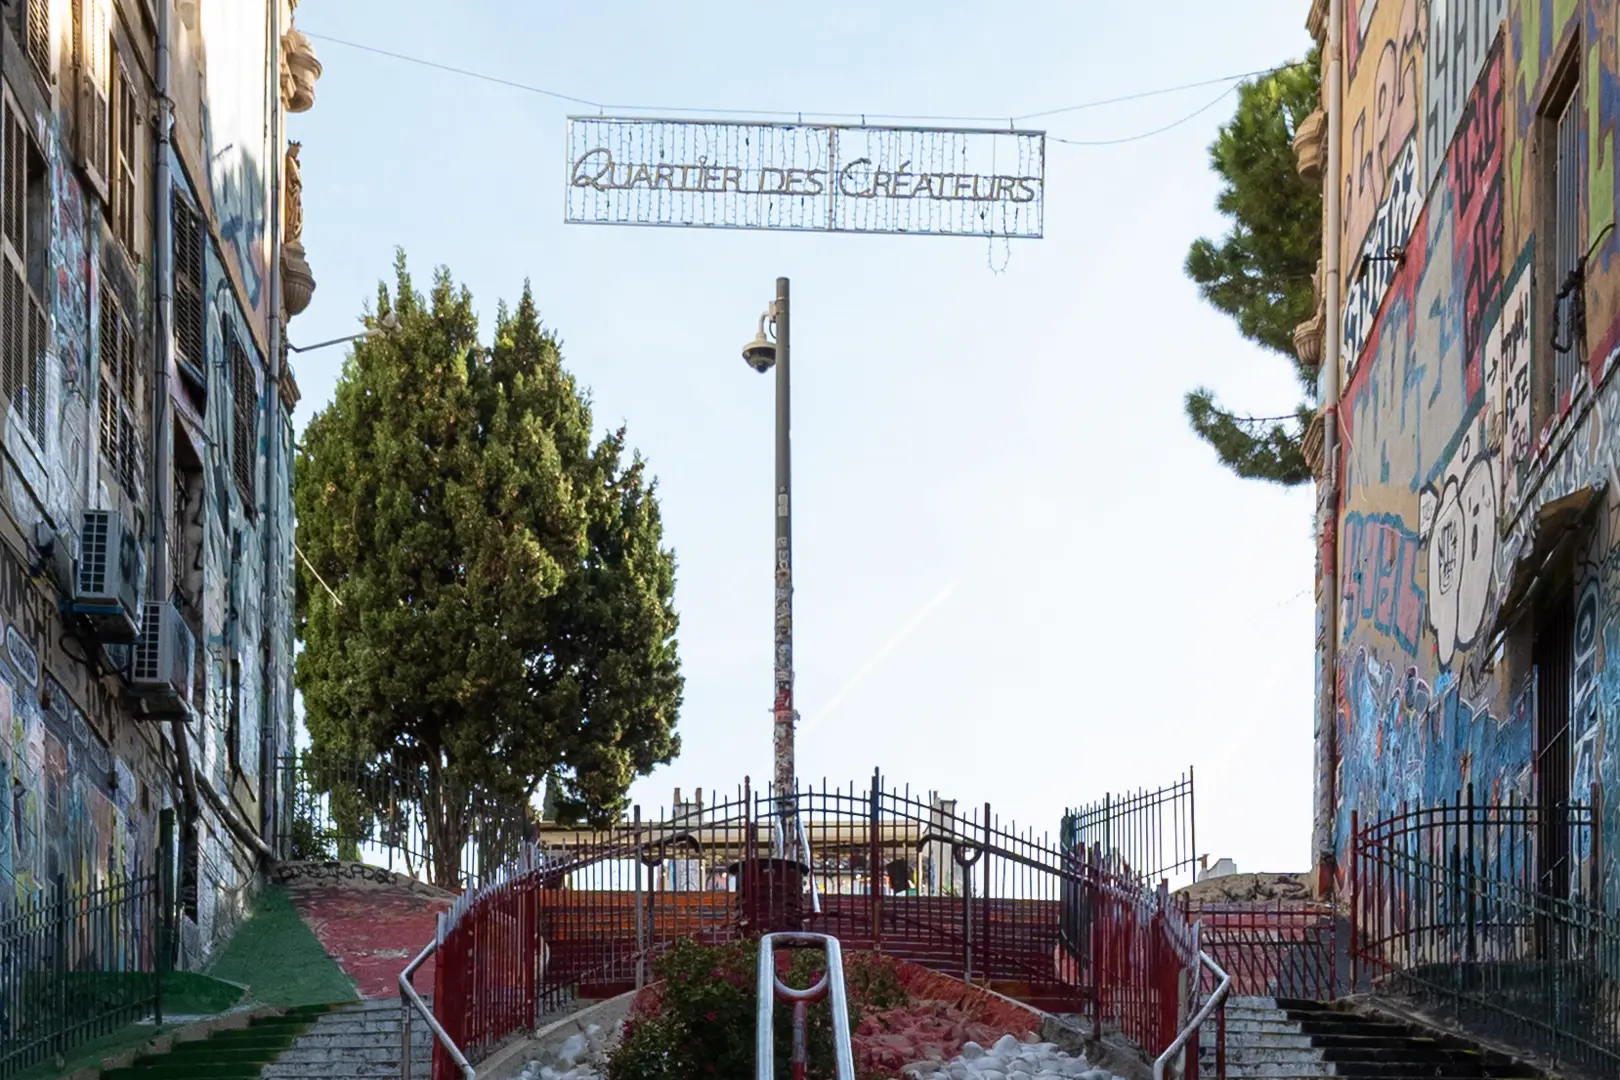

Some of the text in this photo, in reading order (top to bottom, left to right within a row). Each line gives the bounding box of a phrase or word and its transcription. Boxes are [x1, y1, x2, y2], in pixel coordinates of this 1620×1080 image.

[571, 147, 1036, 202] QUARTIER DES CRÉATEURS
